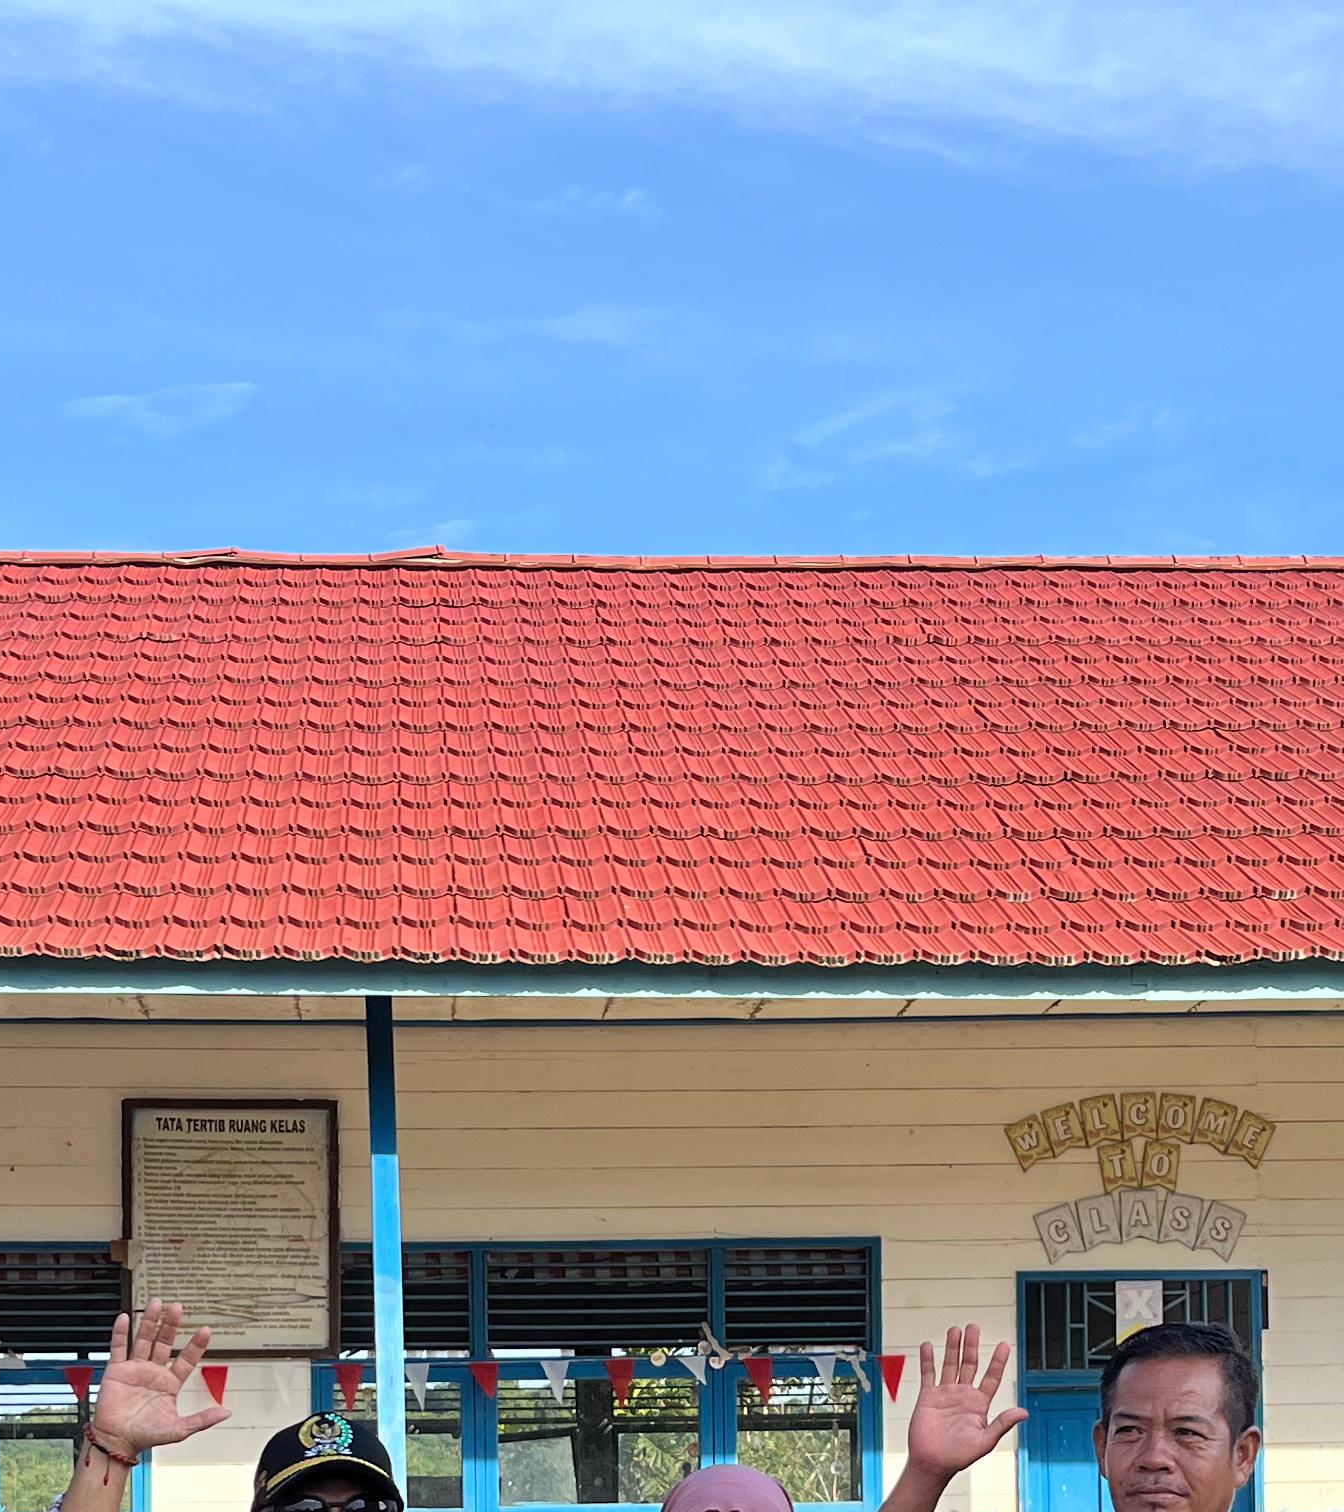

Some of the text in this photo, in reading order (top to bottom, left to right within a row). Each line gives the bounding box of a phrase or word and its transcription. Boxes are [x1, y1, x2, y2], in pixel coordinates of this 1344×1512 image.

[156, 1117, 306, 1133] TATA TERTIB RUANG KELAS
[1016, 1102, 1265, 1151] WELCOME
[1108, 1153, 1172, 1179] TO
[1047, 1201, 1232, 1243] CLASS
